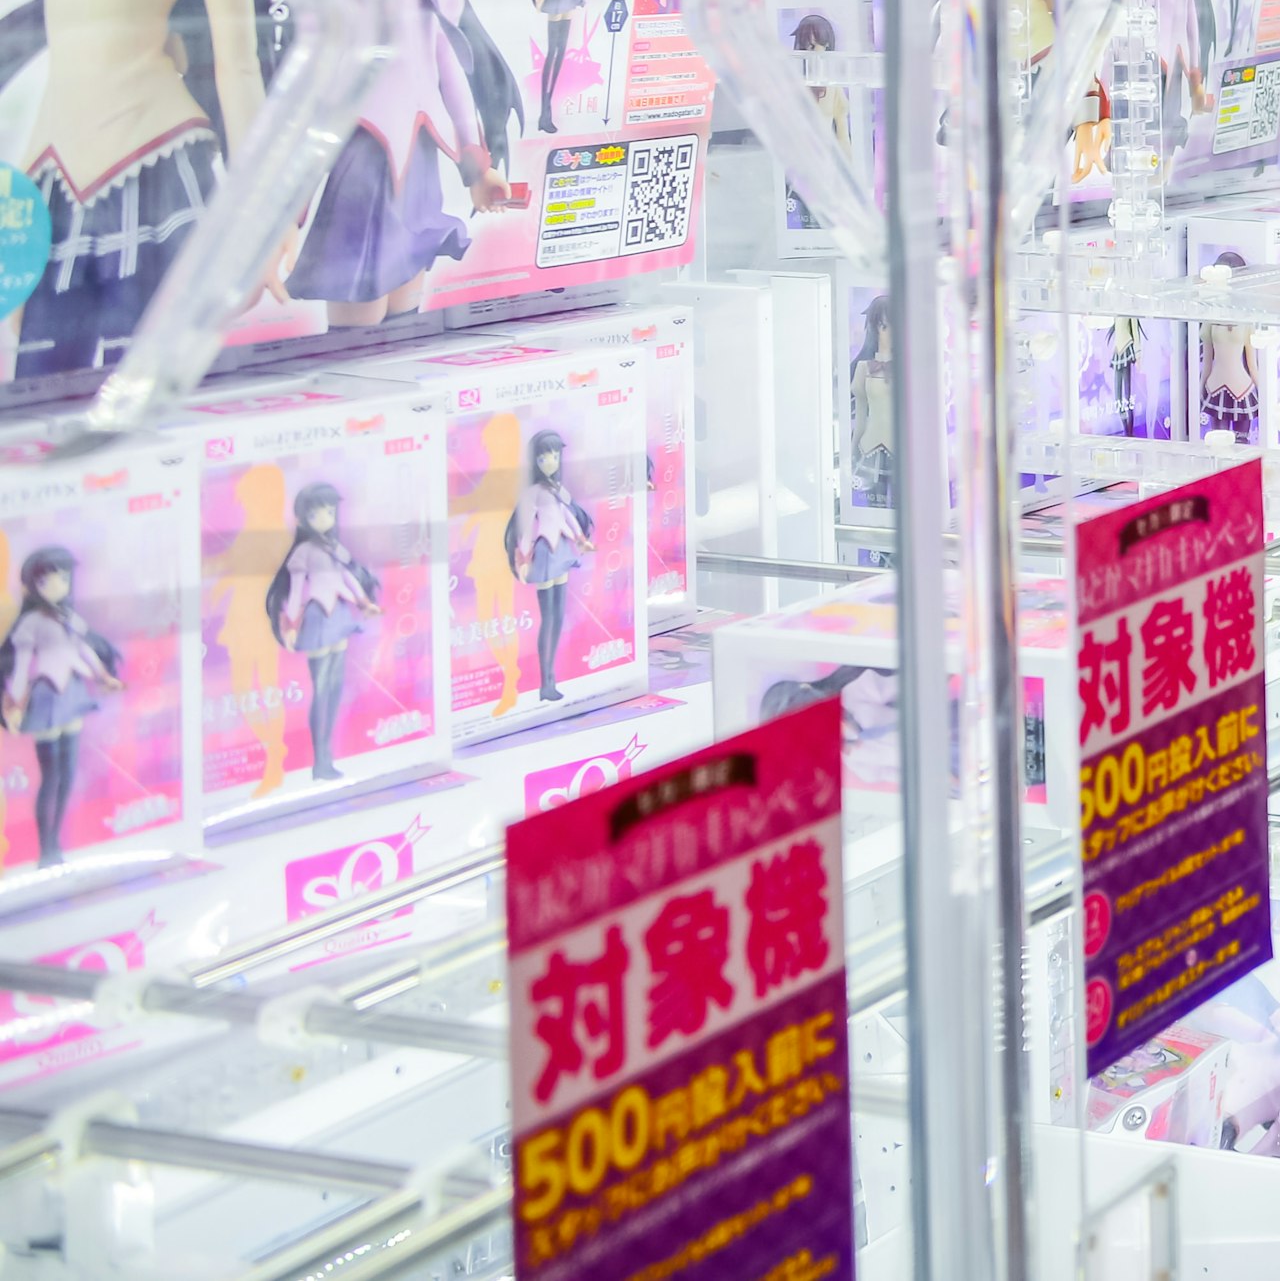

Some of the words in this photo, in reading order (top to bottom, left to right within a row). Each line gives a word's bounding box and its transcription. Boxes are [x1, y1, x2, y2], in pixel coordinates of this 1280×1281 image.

[1078, 565, 1256, 748] 対象機
[531, 833, 831, 1106] 対象機
